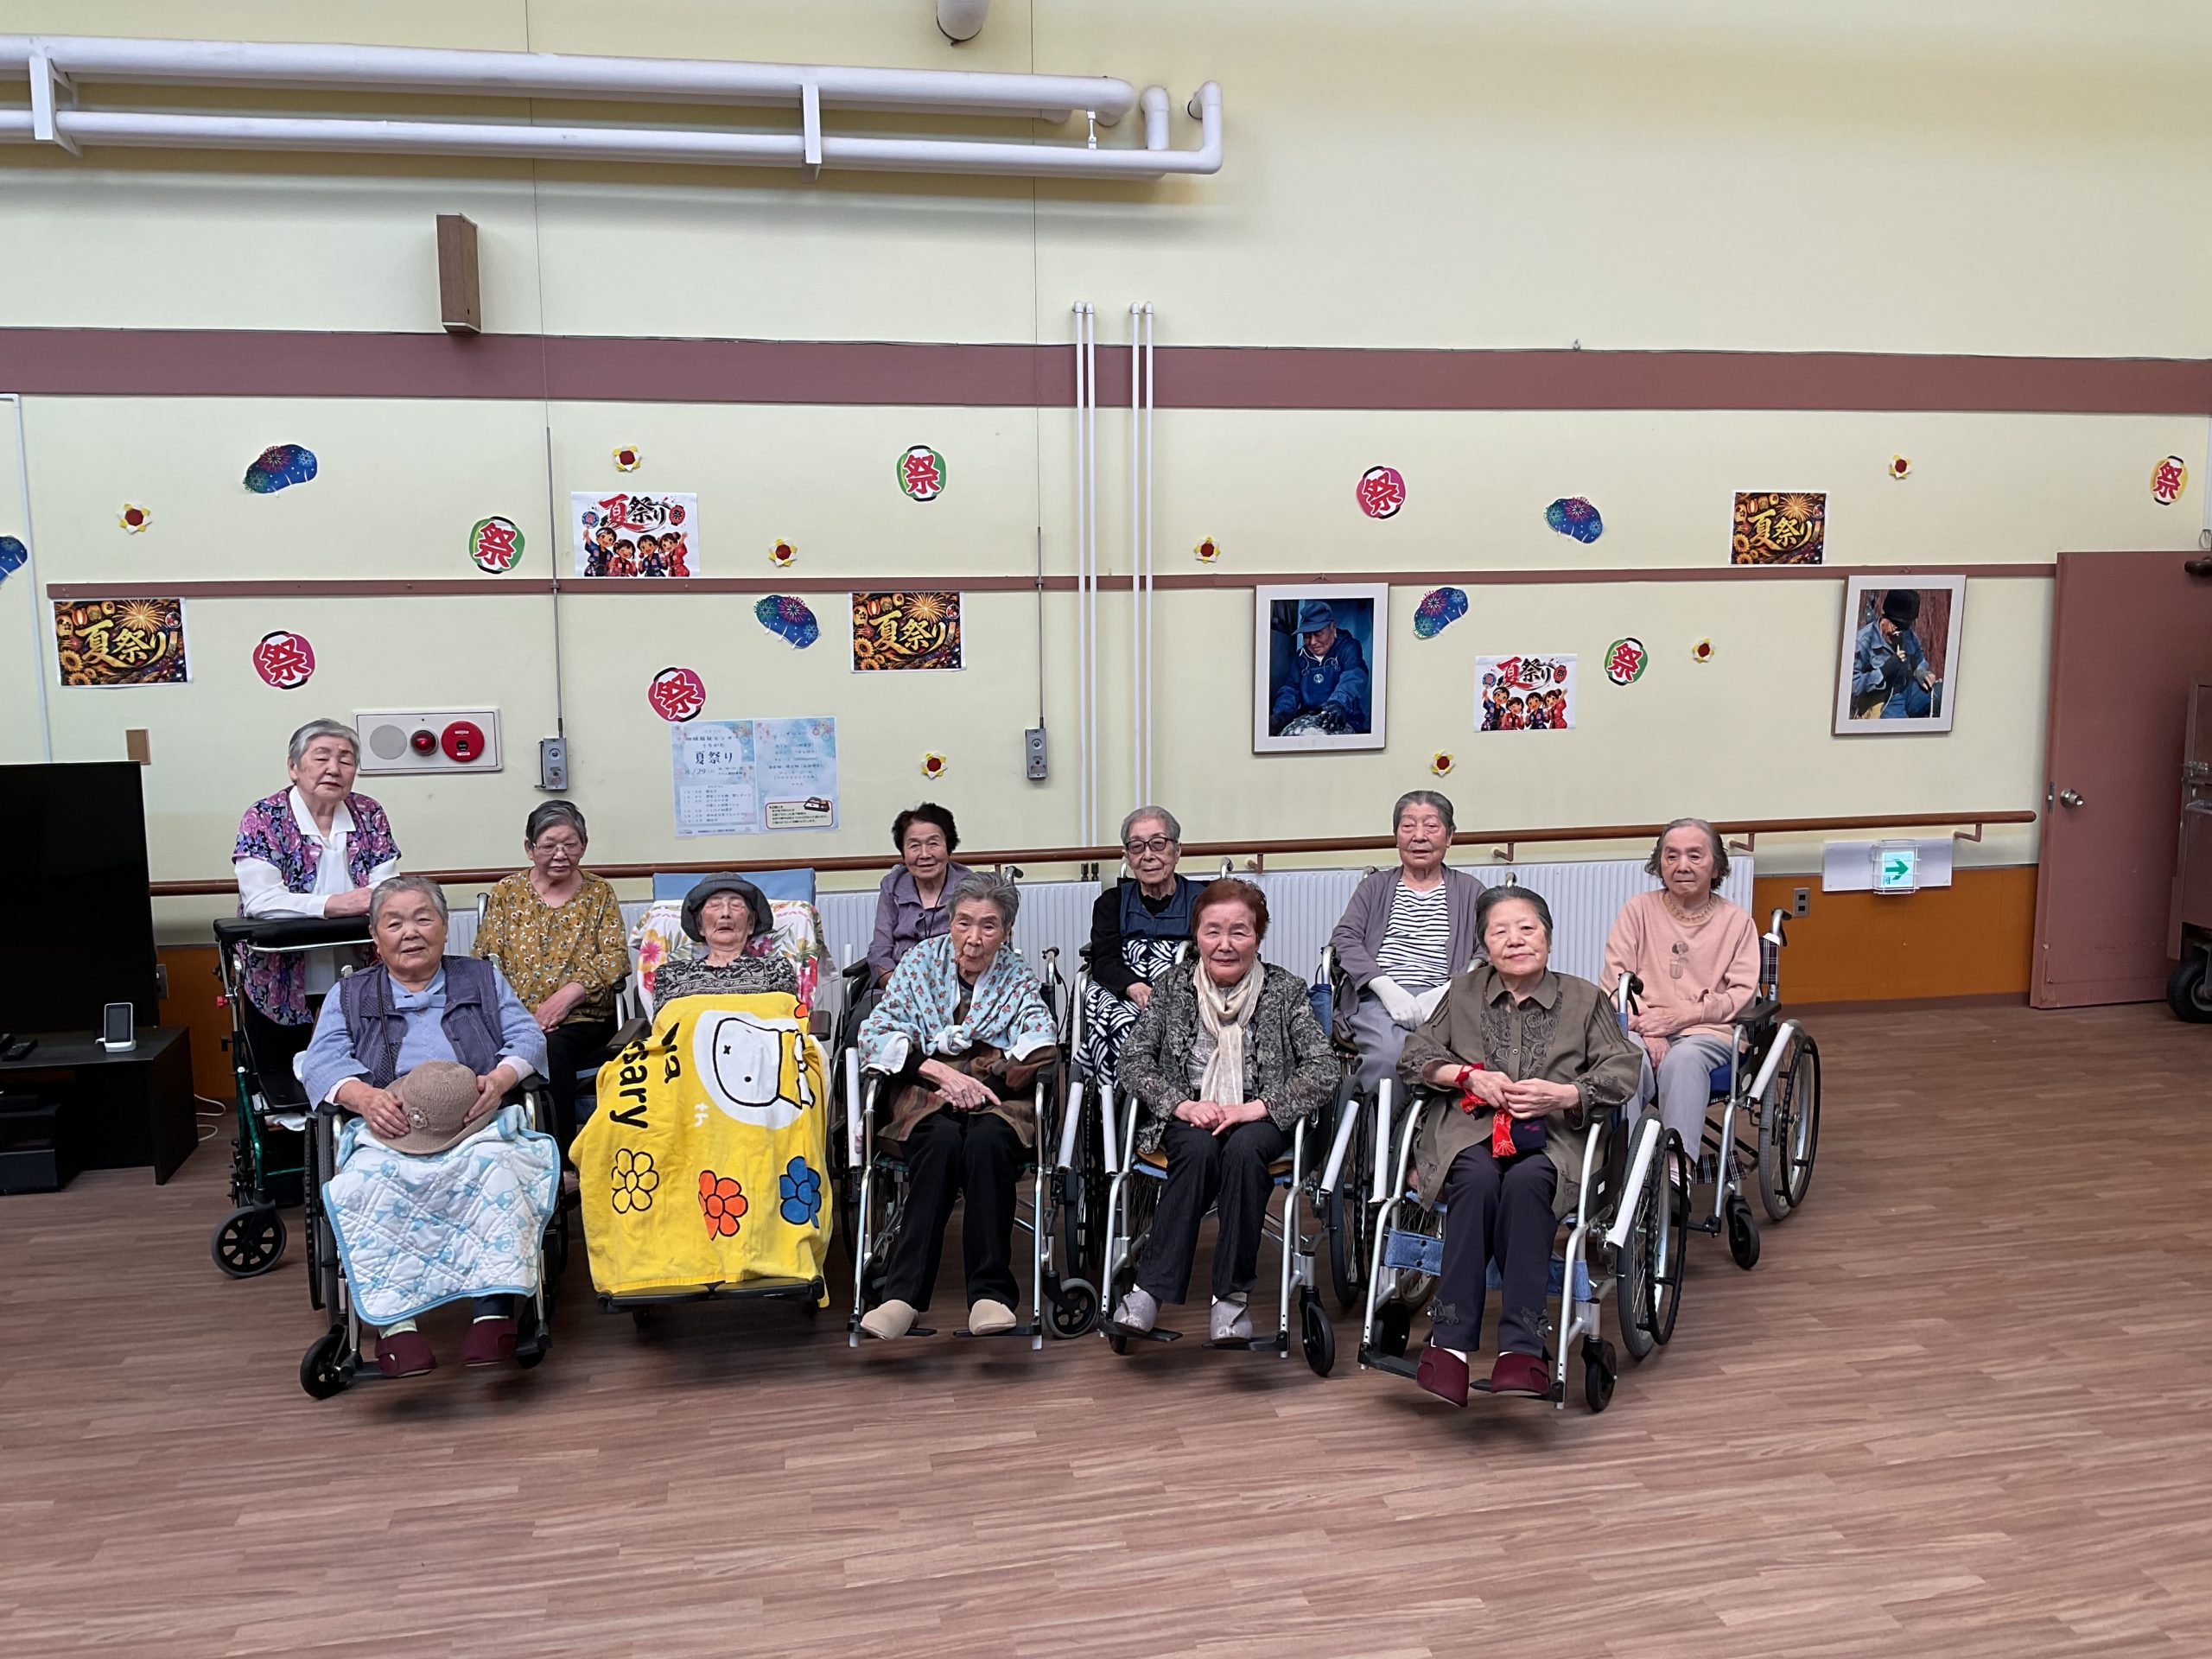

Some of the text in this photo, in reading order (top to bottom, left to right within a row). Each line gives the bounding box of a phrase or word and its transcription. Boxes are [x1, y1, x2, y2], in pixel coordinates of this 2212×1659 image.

[903, 454, 940, 495] 祭
[1363, 471, 1402, 514] 祭
[2152, 461, 2182, 499] 祭
[598, 493, 667, 533] 夏祭り
[1747, 508, 1813, 550] 夏祭り
[474, 521, 517, 569] 祭
[74, 619, 168, 669] 夏祭り
[868, 609, 947, 655] 夏祭り
[260, 638, 311, 683] 祭
[1496, 656, 1552, 690] 夏祭り
[1607, 642, 1642, 681] 祭
[655, 672, 702, 718] 祭
[695, 751, 733, 765] 夏祭り
